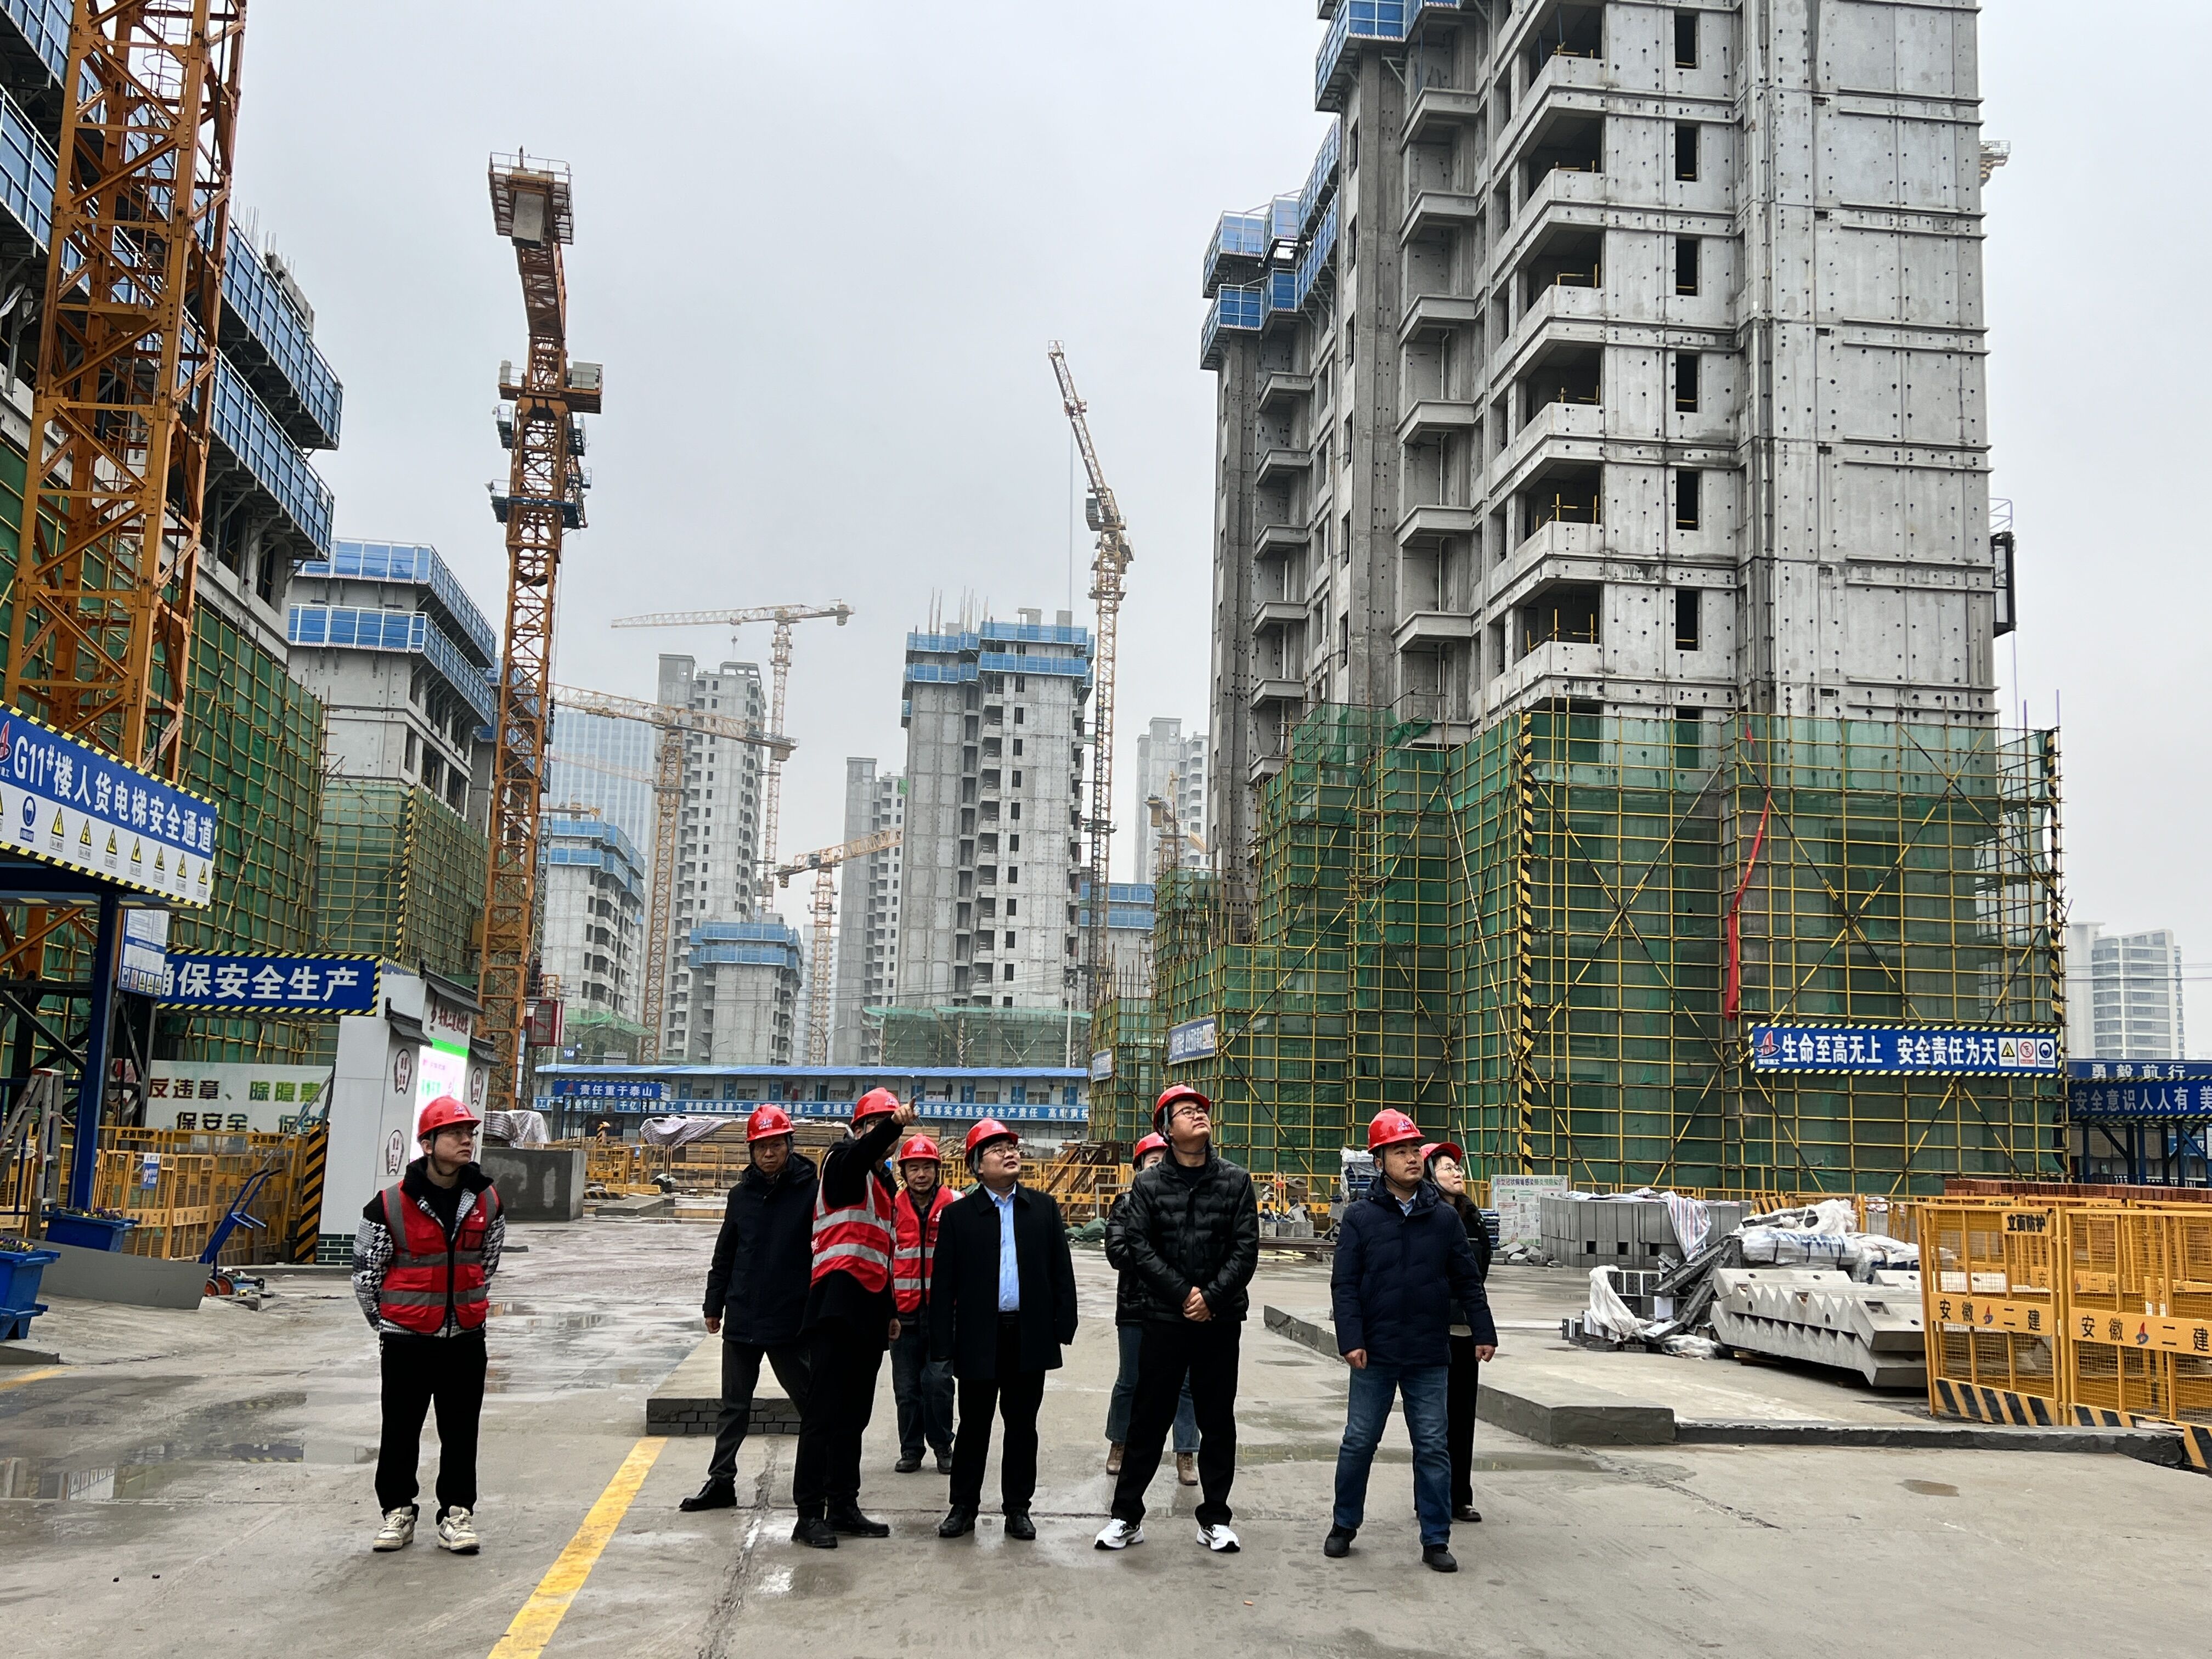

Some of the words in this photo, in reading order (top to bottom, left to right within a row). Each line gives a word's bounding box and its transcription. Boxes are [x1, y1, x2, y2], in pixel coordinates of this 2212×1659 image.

[14, 735, 213, 854] G11#楼人货电梯安全通道
[1782, 1032, 1883, 1064] 生命至高无上
[1897, 1035, 1997, 1066] 安全责任为天
[2091, 1063, 2186, 1079] 勇毅前行
[579, 1084, 653, 1097] 责任重于泰山
[2075, 1086, 2188, 1113] 安全意识人人有
[2007, 1214, 2046, 1233] 立面防护
[1939, 1298, 2041, 1331] 安徽二建
[2081, 1314, 2210, 1352] 安徽二建
